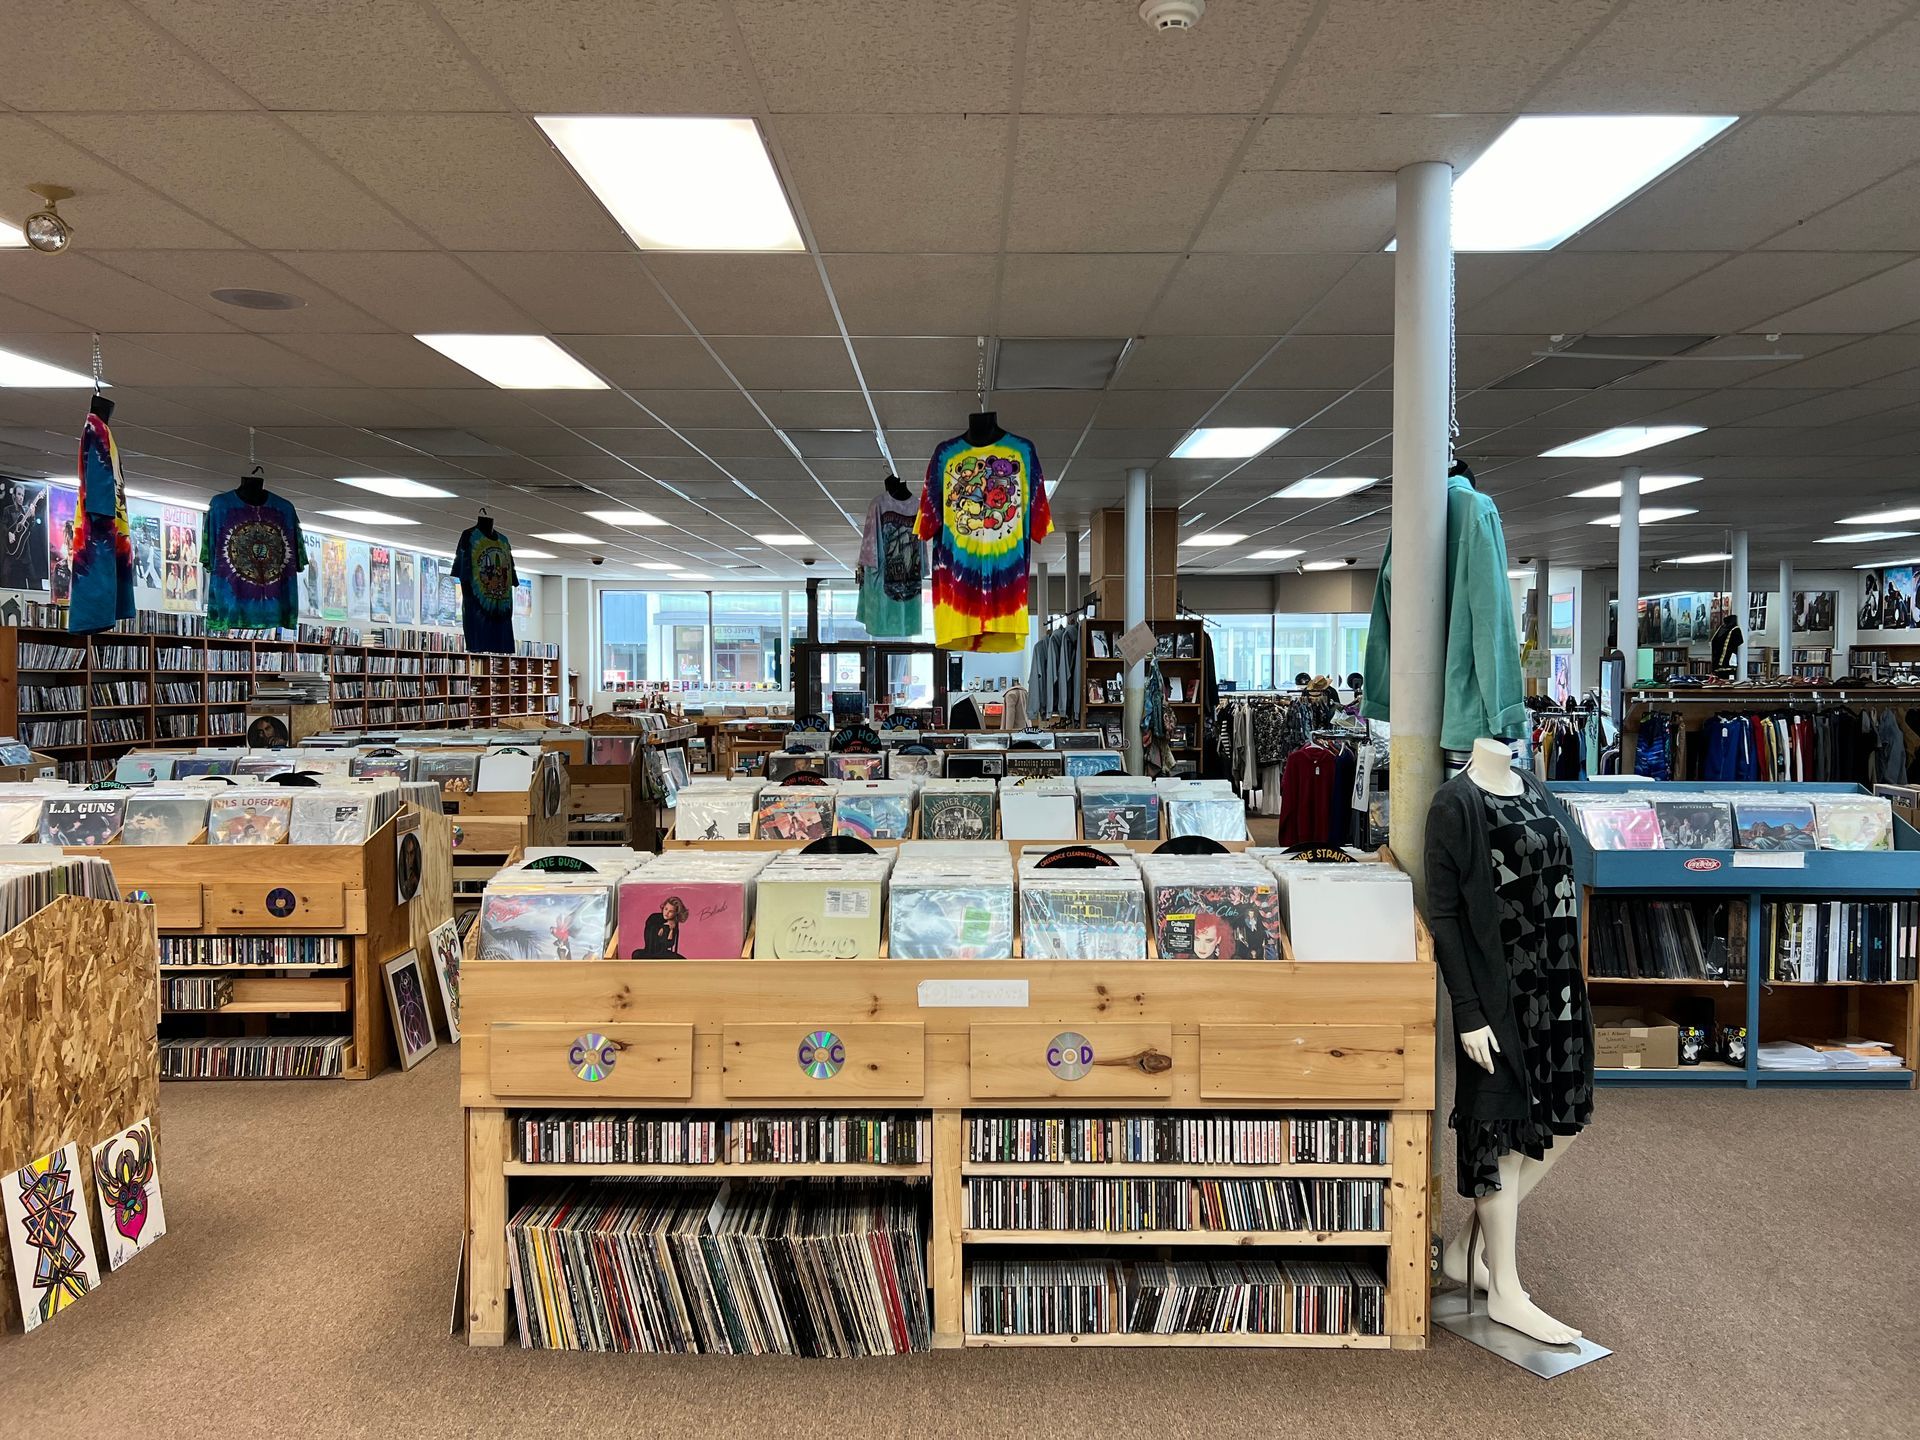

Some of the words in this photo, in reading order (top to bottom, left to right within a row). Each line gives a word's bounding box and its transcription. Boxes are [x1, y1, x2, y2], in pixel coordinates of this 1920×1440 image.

[303, 534, 321, 548] ASH
[836, 729, 853, 745] HIP
[858, 729, 879, 745] HOP
[49, 803, 75, 814] L.A.
[77, 802, 116, 814] GUNS
[213, 800, 237, 808] NILS
[242, 798, 289, 807] LOFGREN
[930, 798, 959, 815] MOTHER
[962, 798, 985, 815] EARTH
[1040, 853, 1065, 867] CREEDENCE
[1066, 851, 1095, 859] CLEARWATER
[1096, 854, 1113, 866] REVIVAL
[1316, 849, 1350, 863] STRAITS
[531, 857, 555, 869] KATE
[558, 857, 583, 870] BUSH
[1216, 905, 1240, 917] Club
[1679, 1027, 1705, 1037] ECORD
[1047, 1048, 1061, 1067] C
[1080, 1045, 1093, 1065] D
